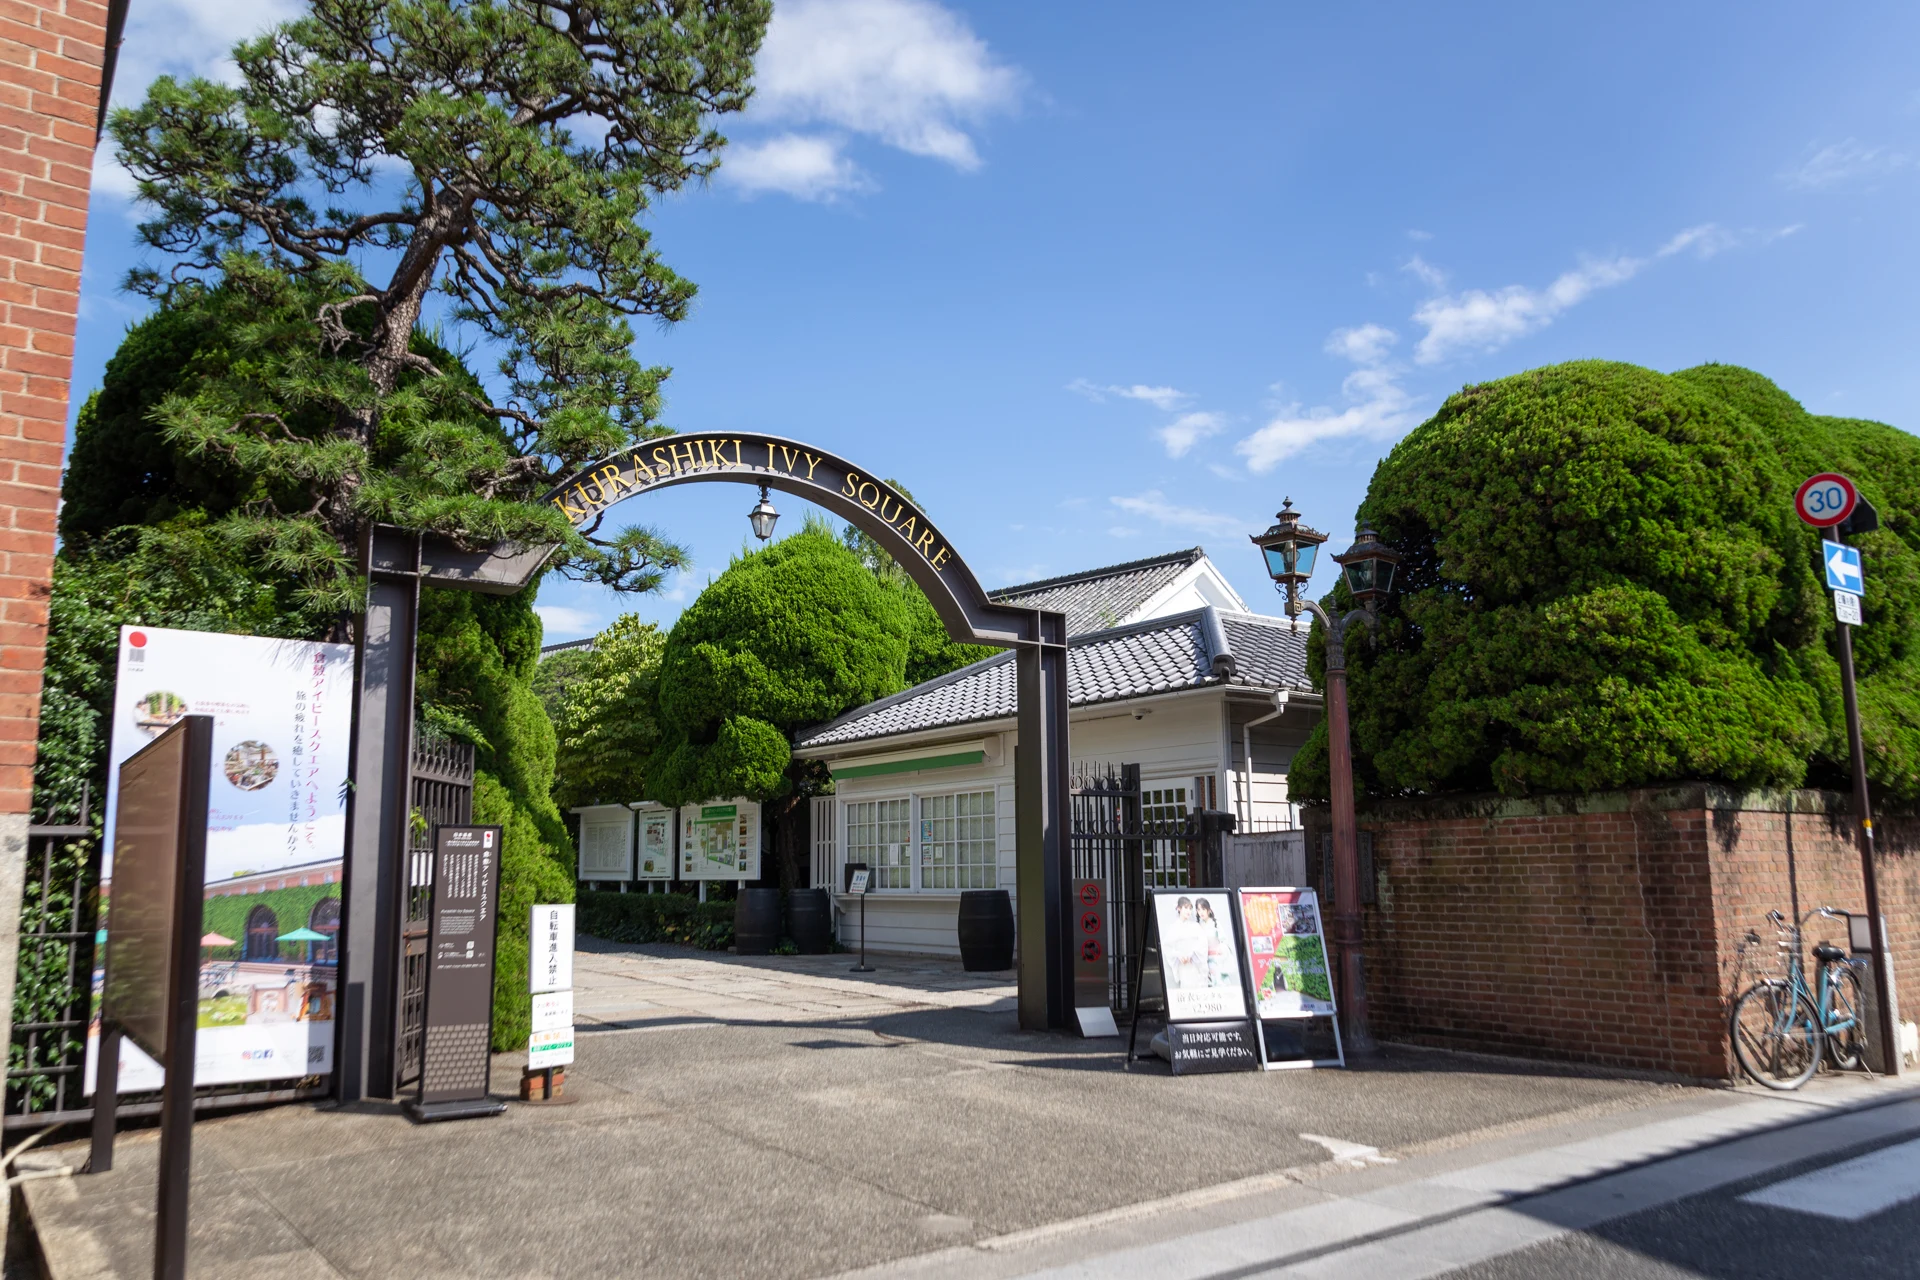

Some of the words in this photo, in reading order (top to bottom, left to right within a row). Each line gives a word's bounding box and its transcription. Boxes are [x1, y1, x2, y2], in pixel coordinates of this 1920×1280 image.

[552, 439, 742, 524] KURASHIKI
[766, 443, 823, 481] IVY
[841, 472, 952, 572] SQUARE
[1808, 487, 1843, 513] 30
[548, 909, 559, 986] 自転車進入禁止
